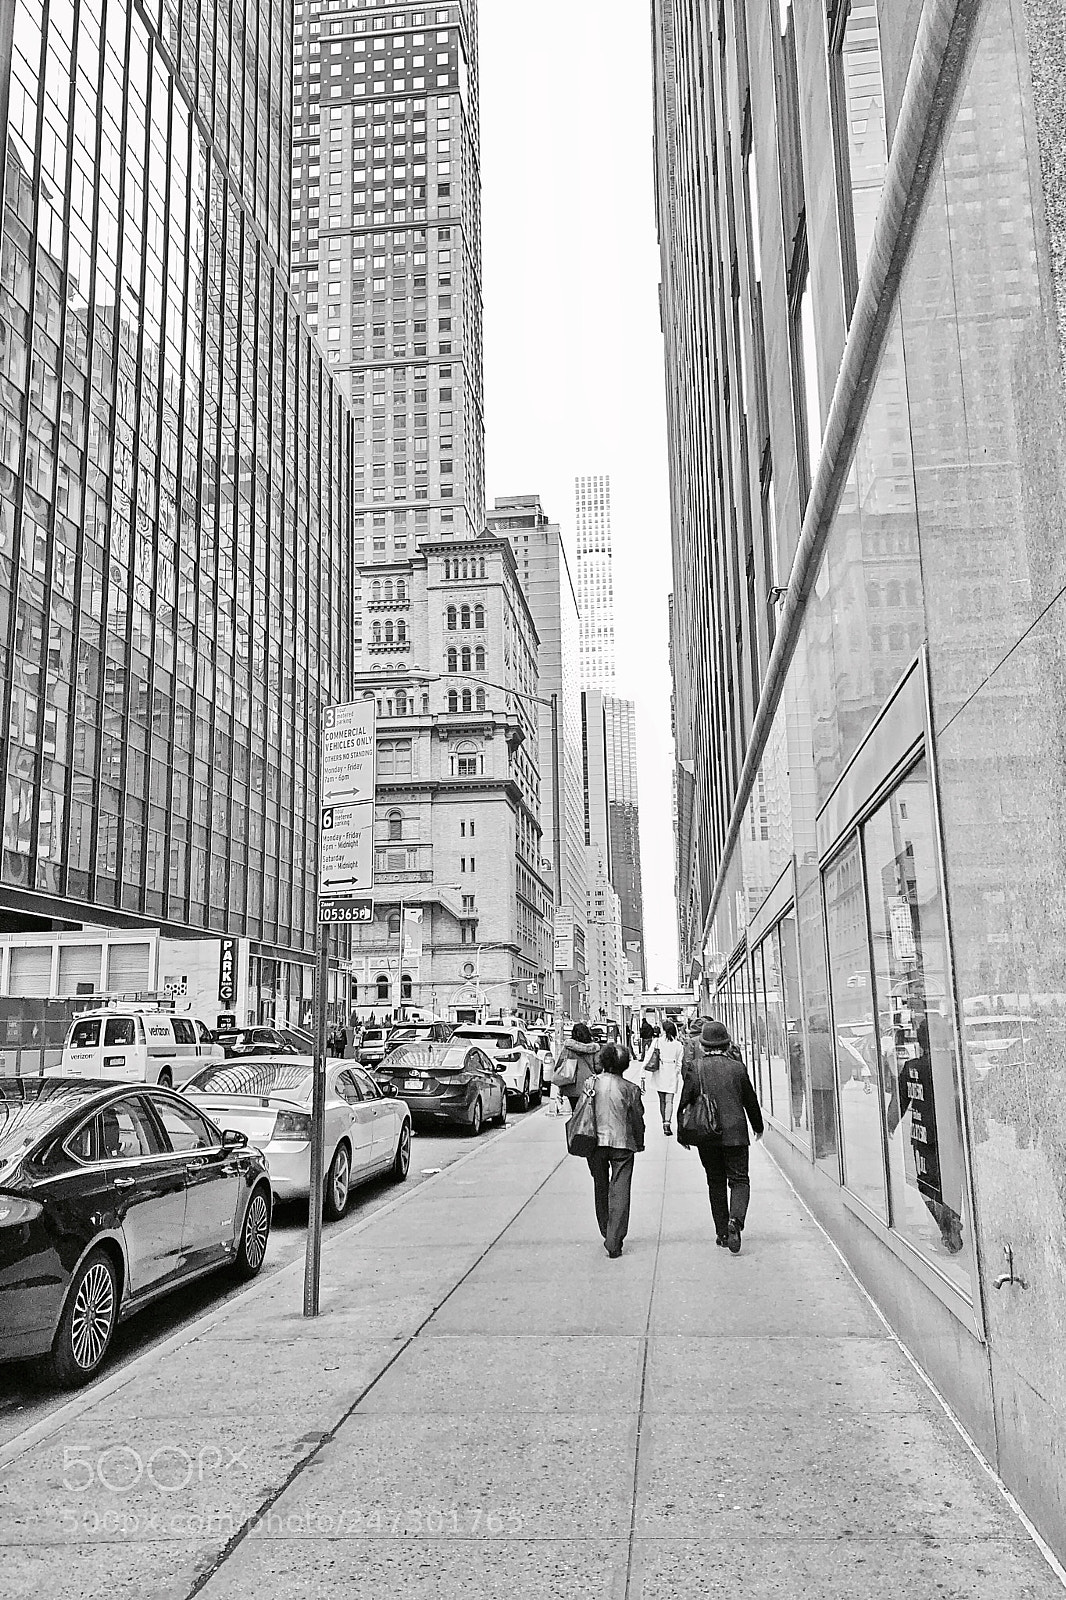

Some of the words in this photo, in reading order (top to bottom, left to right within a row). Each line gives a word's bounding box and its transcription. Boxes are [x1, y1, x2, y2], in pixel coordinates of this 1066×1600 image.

[326, 709, 334, 728] 3
[326, 726, 366, 741] COMMERCIAL
[326, 739, 354, 751] VEHICLES
[356, 736, 372, 746] ONLY
[325, 754, 342, 763] OTHERS
[350, 750, 372, 759] STANDING
[325, 765, 343, 774] Monday
[323, 809, 332, 828] 6
[338, 840, 358, 850] Midnight
[338, 861, 358, 870] Midnight
[321, 908, 359, 920] 105365
[223, 940, 233, 982] PARK
[148, 1025, 170, 1036] verizon
